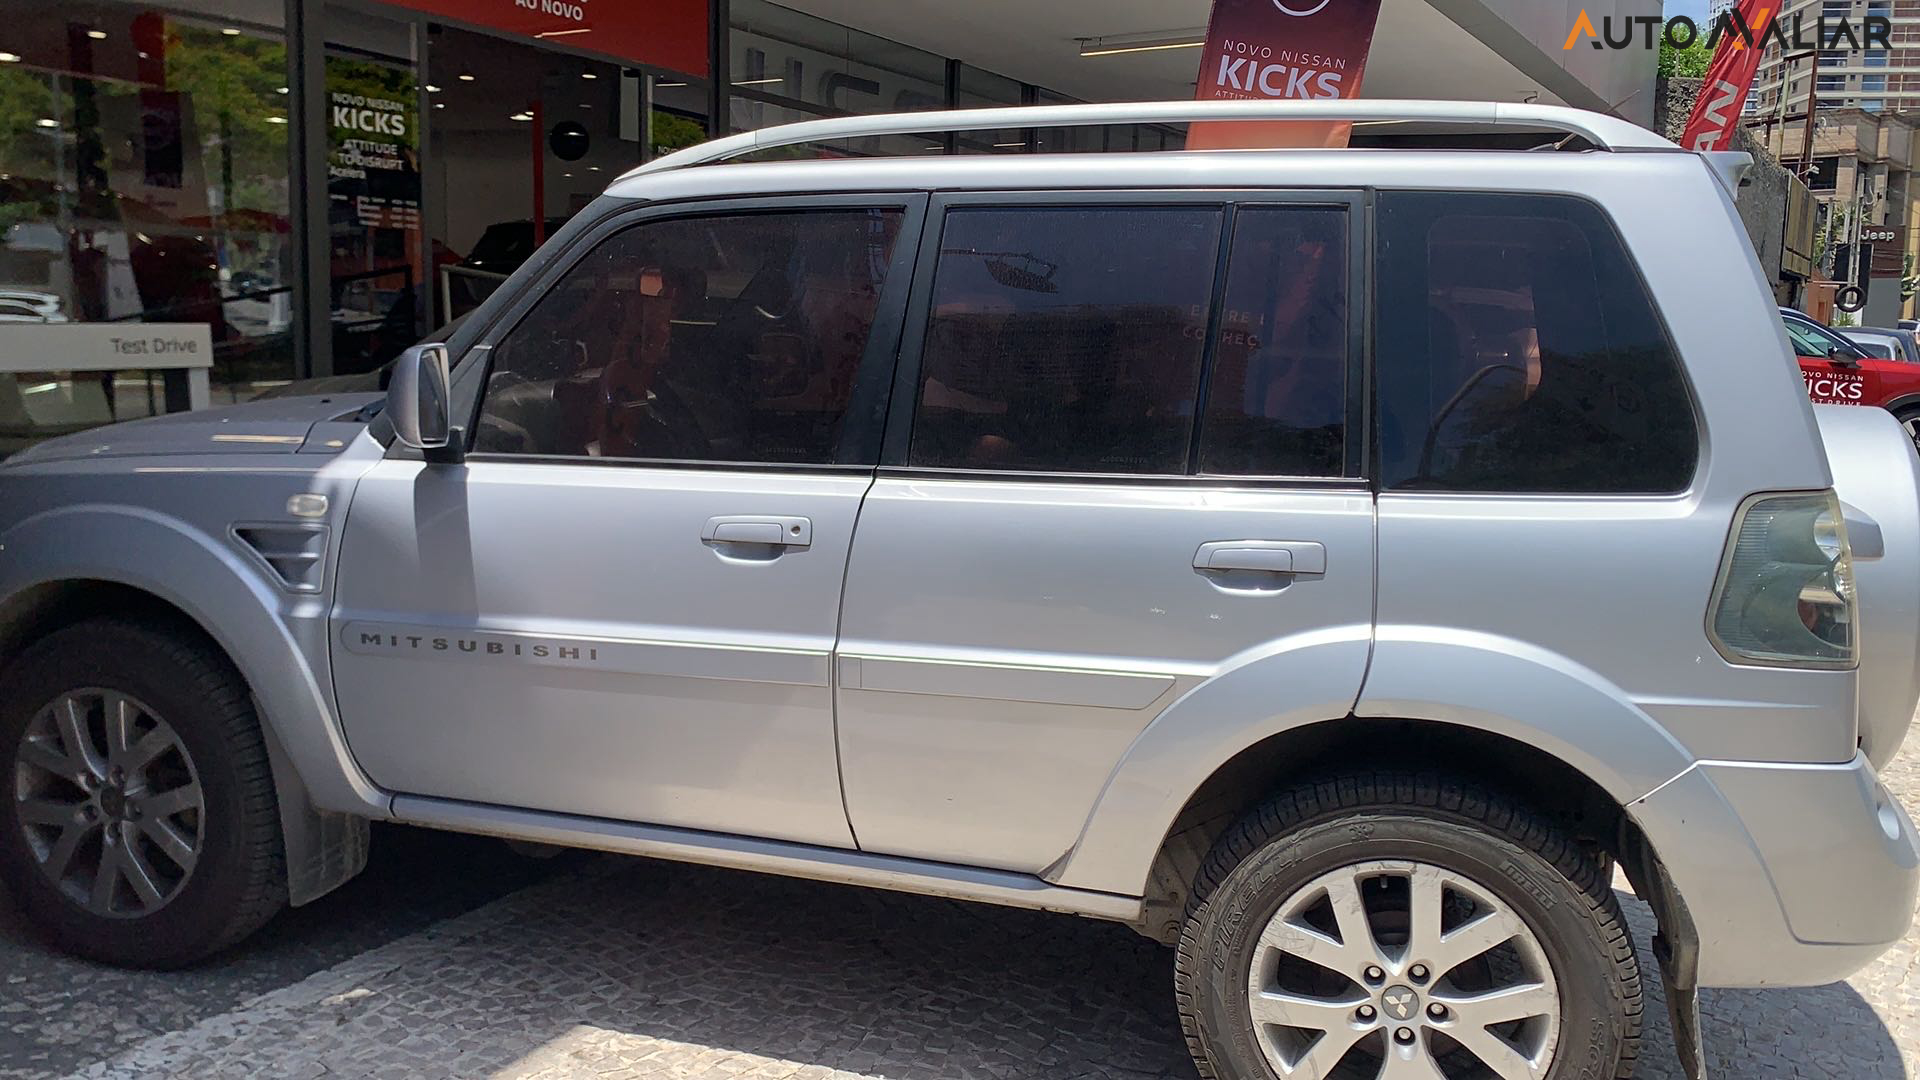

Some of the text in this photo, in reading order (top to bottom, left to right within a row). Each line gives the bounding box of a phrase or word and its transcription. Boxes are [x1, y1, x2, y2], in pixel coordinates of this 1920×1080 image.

[541, 0, 584, 21] NOVO
[1223, 39, 1347, 70] NOVO NISSAN
[1216, 54, 1342, 100] KICKS
[333, 105, 406, 136] KICKS
[342, 138, 398, 155] ATTITUDE
[1860, 229, 1896, 242] Jeep
[109, 337, 198, 354] Test Drive
[1801, 370, 1864, 382] OVO NISSAN
[1804, 378, 1863, 399] ICKS
[360, 633, 597, 661] MITSUBISHI
